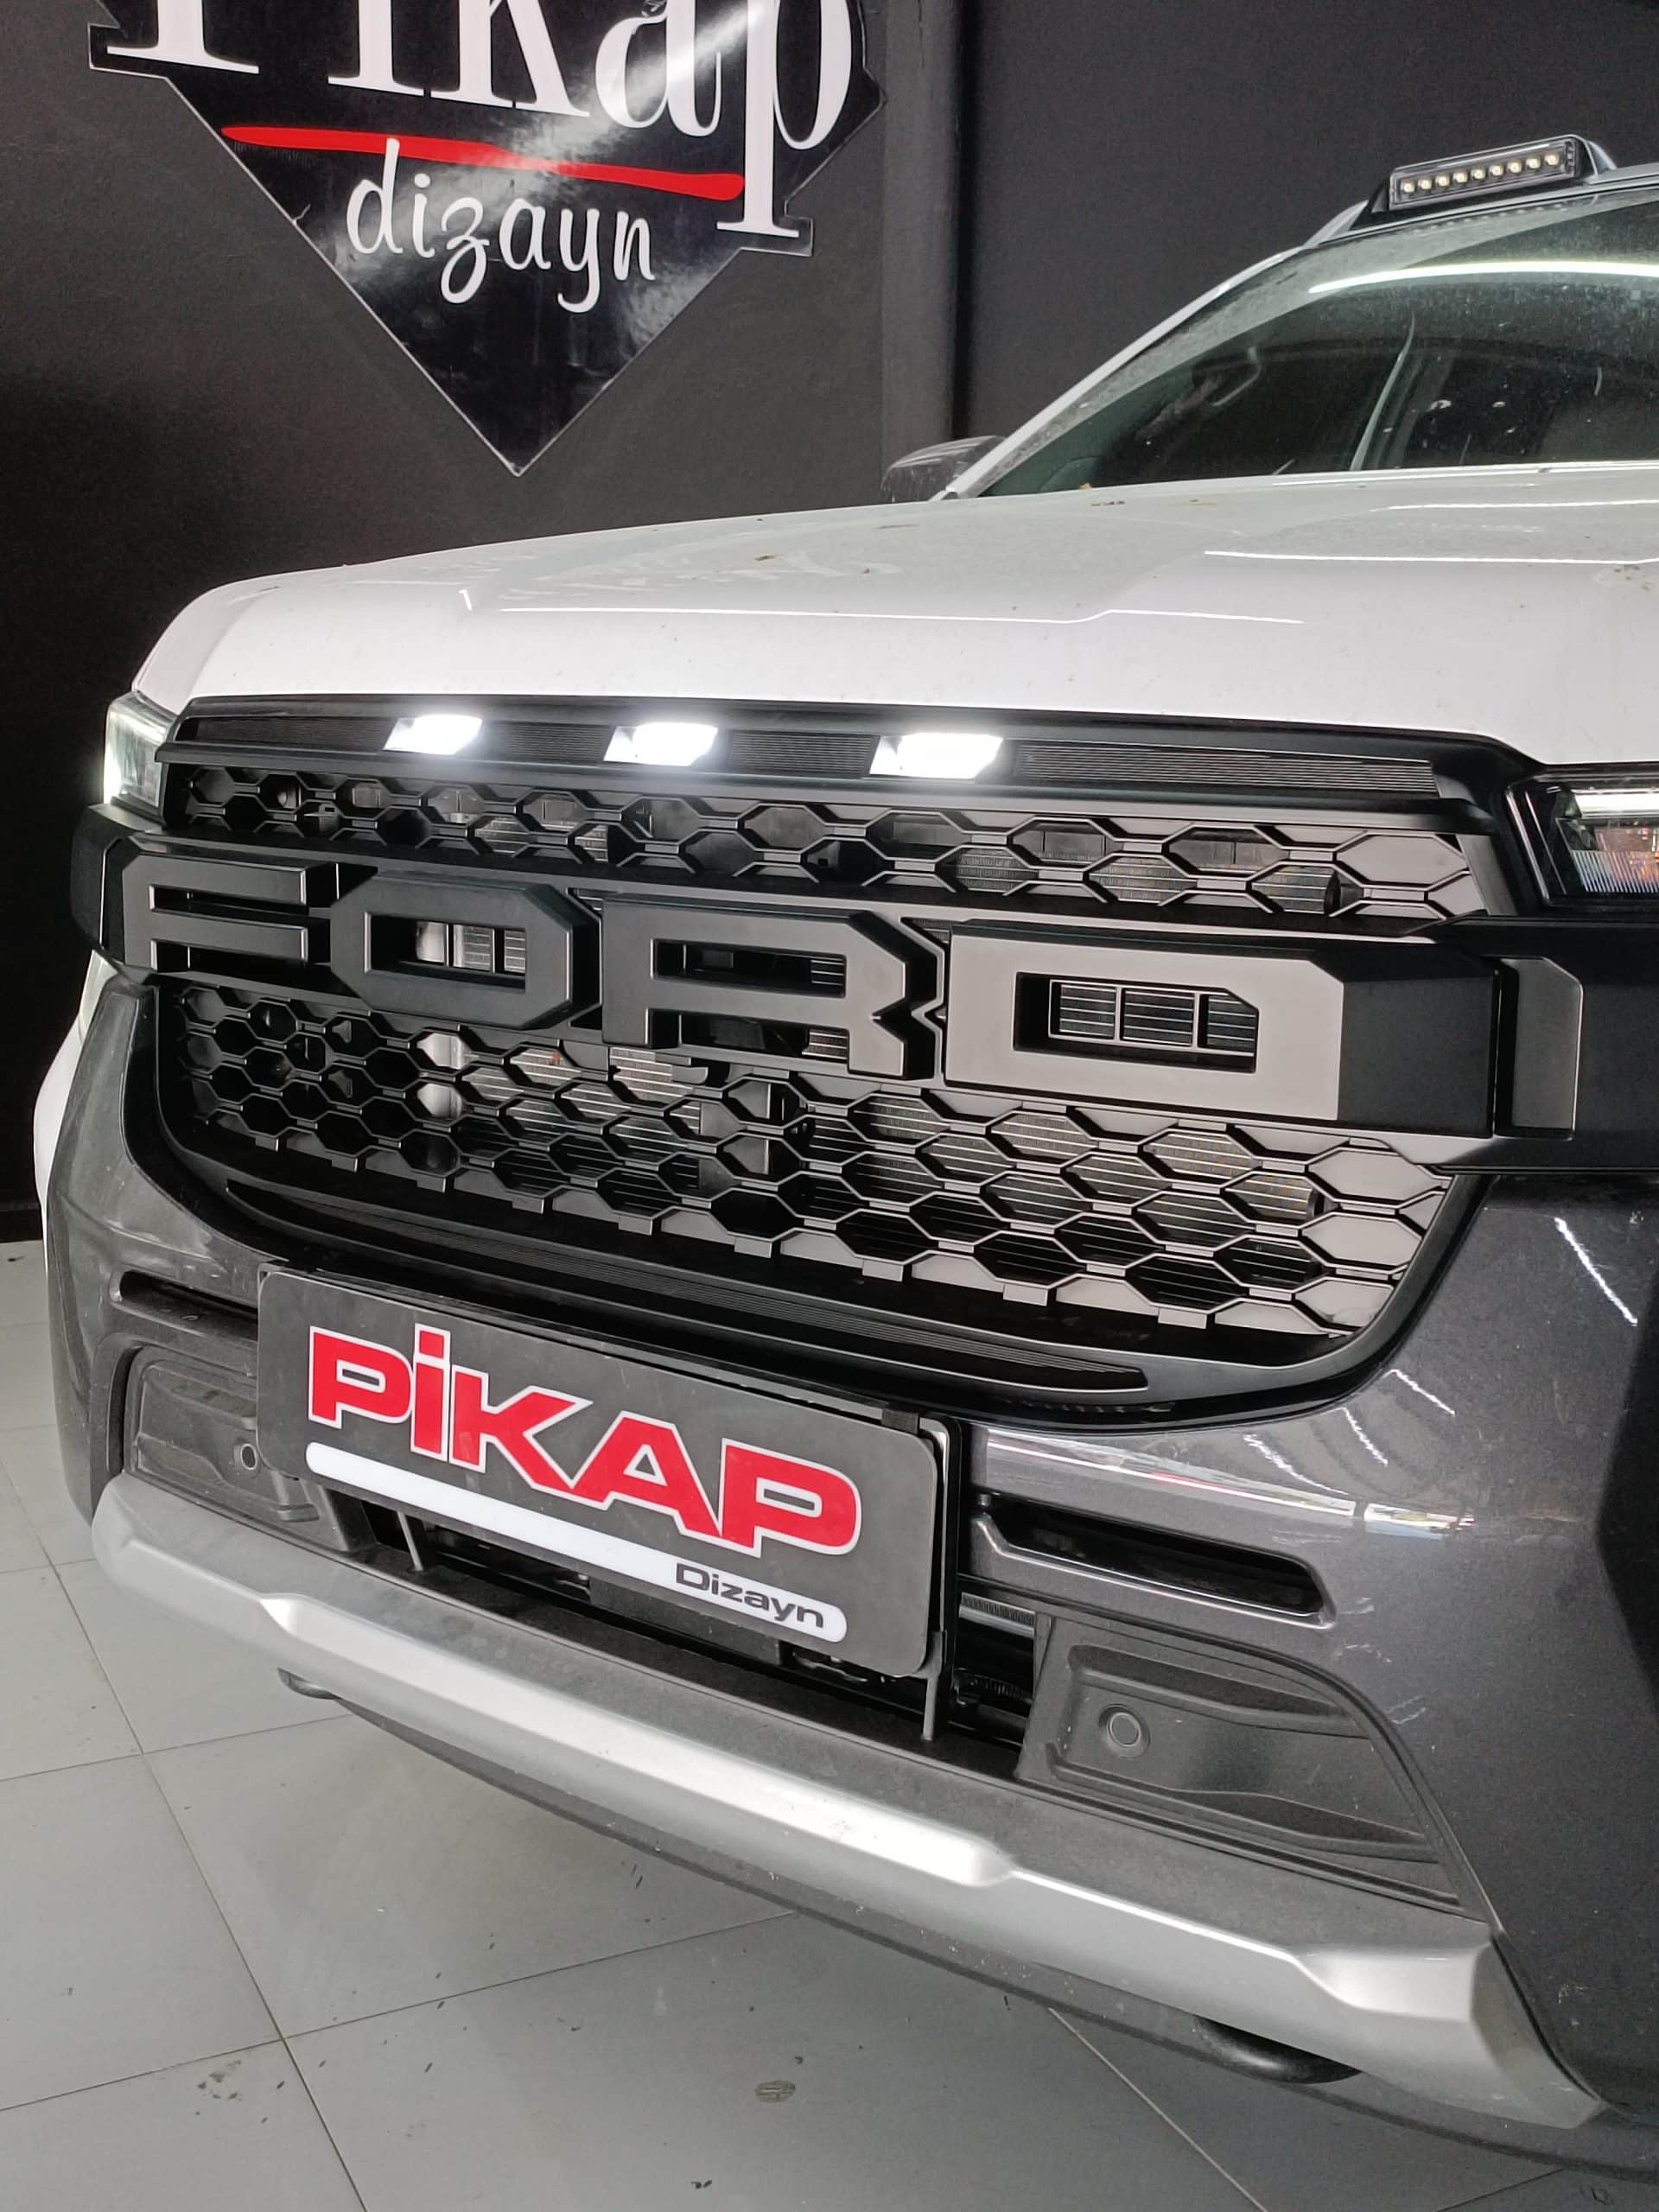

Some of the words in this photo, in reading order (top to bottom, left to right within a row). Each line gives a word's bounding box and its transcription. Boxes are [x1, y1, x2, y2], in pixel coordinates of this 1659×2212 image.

[346, 138, 655, 312] dizayn
[122, 862, 1345, 1122] FORD
[675, 1561, 824, 1629] Dizayn
